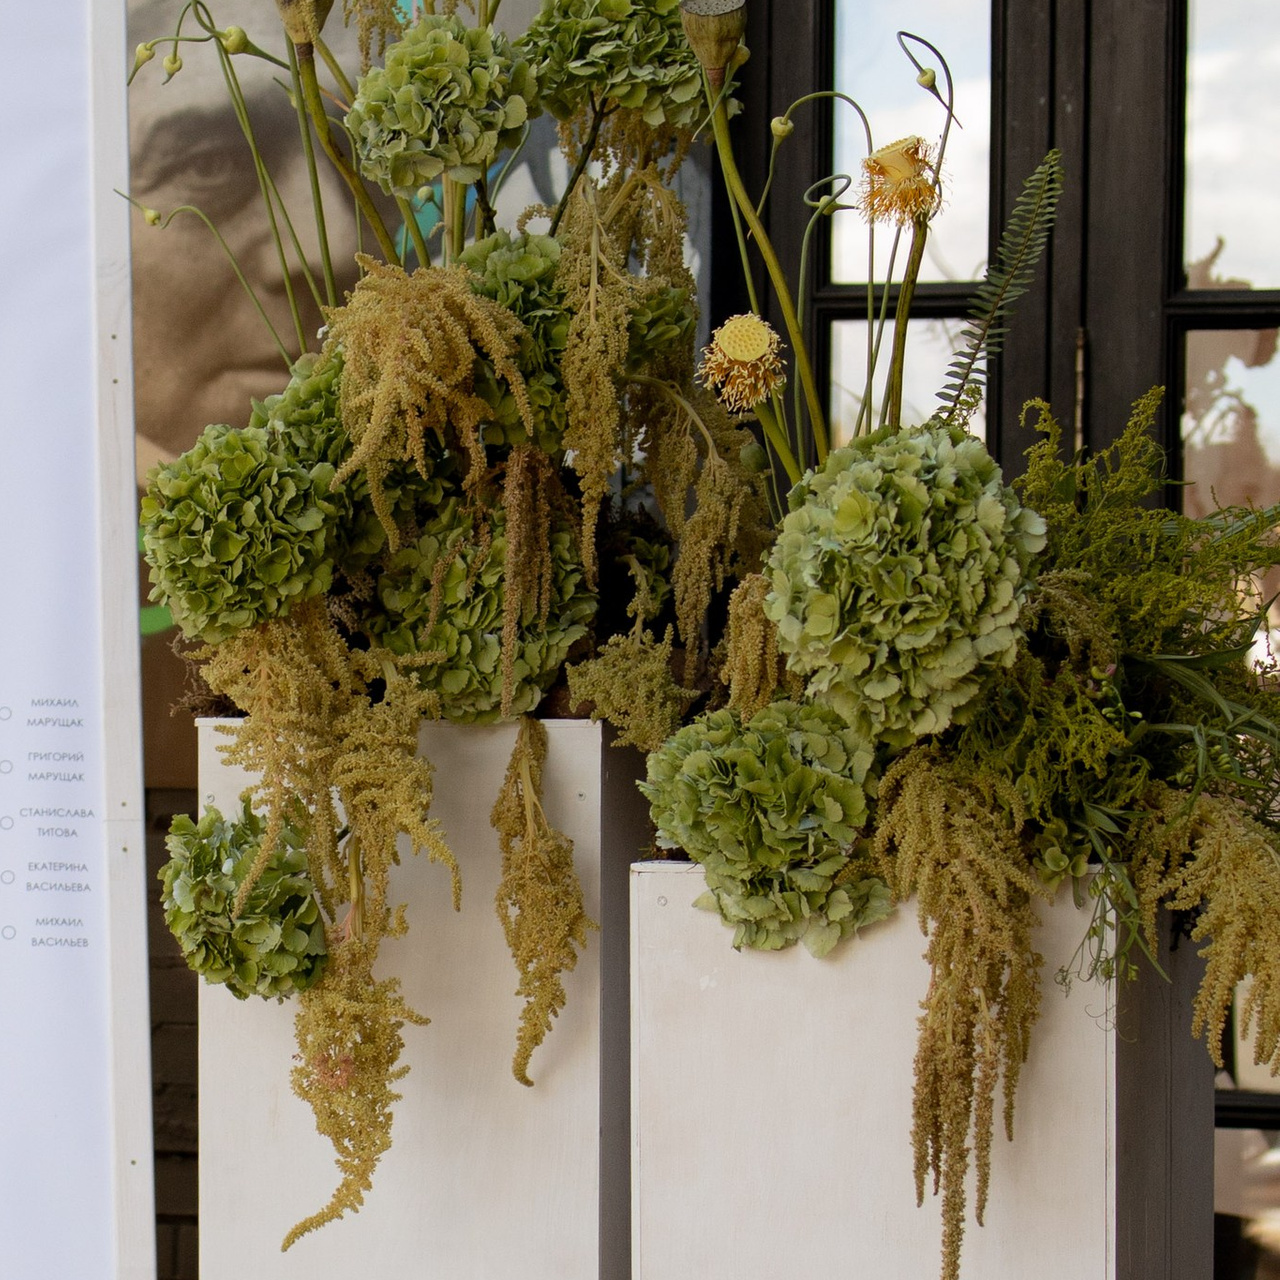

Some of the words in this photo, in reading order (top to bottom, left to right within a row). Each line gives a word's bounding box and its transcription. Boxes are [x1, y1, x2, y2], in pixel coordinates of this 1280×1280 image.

[29, 697, 80, 709] МИХАИЛ
[25, 717, 84, 728] МАРУЩАК
[26, 751, 85, 763] ГРИГОРИЙ
[26, 771, 85, 783] МАРУЩАК
[18, 807, 96, 819] СТАНИСЛАВА
[36, 827, 79, 838] ТИТОВА
[26, 861, 89, 873] ЕКАТЕРИНА
[24, 881, 92, 893] ВАСИЛЬЕВА
[34, 916, 84, 928] МИХАИЛ
[30, 936, 90, 948] ВАСИЛЬЕВ
